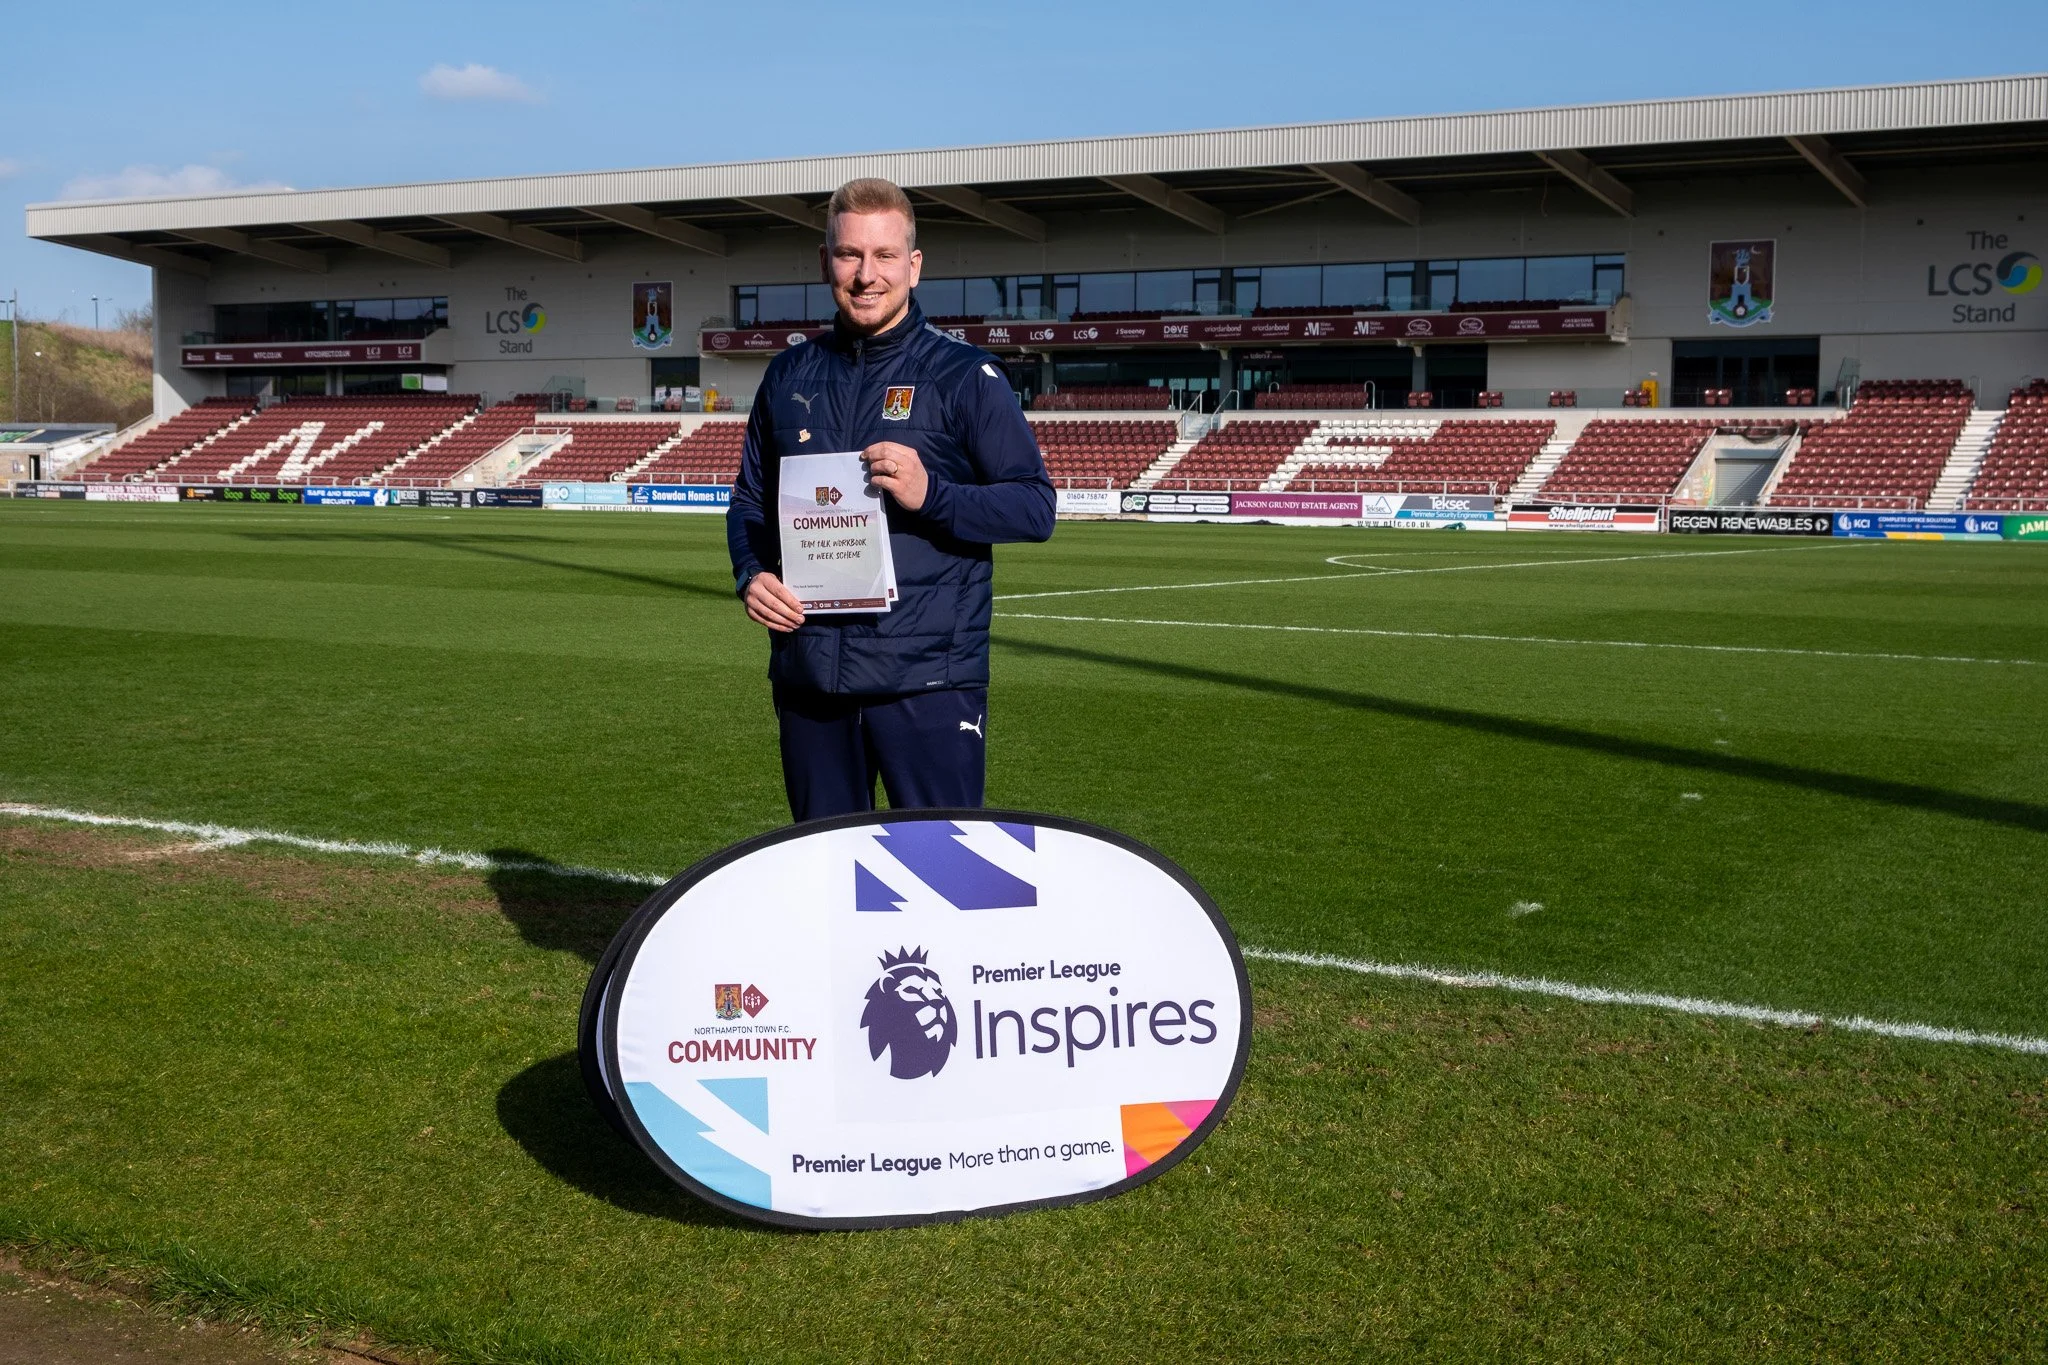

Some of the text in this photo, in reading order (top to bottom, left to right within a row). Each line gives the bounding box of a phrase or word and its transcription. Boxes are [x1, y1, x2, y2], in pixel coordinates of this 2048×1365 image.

[1966, 230, 2009, 251] The
[1928, 262, 1994, 297] LCS
[504, 286, 528, 301] The
[1952, 302, 2016, 324] Stand
[485, 310, 520, 335] LCS
[988, 328, 1010, 338] A&L
[1120, 328, 1146, 336] Sweeney
[1163, 325, 1189, 334] DOVE
[1029, 331, 1044, 340] LCS
[1073, 330, 1088, 340] LCS
[366, 347, 381, 356] LCJ
[397, 346, 412, 355] LCJ
[499, 339, 533, 354] Stand
[86, 485, 178, 494] SIXFIELDS TRAVEL CLUB
[652, 490, 687, 501] Snowdon
[687, 490, 715, 501] Homes
[716, 491, 730, 502] Ltd
[1235, 501, 1268, 509] JACKSON
[1301, 502, 1328, 510] ESTATE
[1329, 502, 1358, 510] AGENTS
[1429, 496, 1470, 510] Teksec
[1365, 504, 1386, 513] Teksec
[1458, 512, 1488, 520] Engineering
[1548, 506, 1617, 522] Shellplant
[793, 515, 868, 530] COMMUNITY
[1673, 516, 1813, 531] REGEN RENEWABLES
[1853, 519, 1871, 529] KCI
[1980, 521, 1998, 530] KCI
[800, 540, 816, 548] TEAM
[833, 538, 867, 547] WORKBOOK
[836, 551, 861, 559] SCHEME
[972, 960, 1122, 984] Premier League
[694, 1025, 792, 1035] NORTHAMPTON TOWN F.C.
[973, 986, 1218, 1068] Inspires
[668, 1038, 817, 1064] COMMUNITY
[792, 1139, 1115, 1176] Premier League More than a game.
